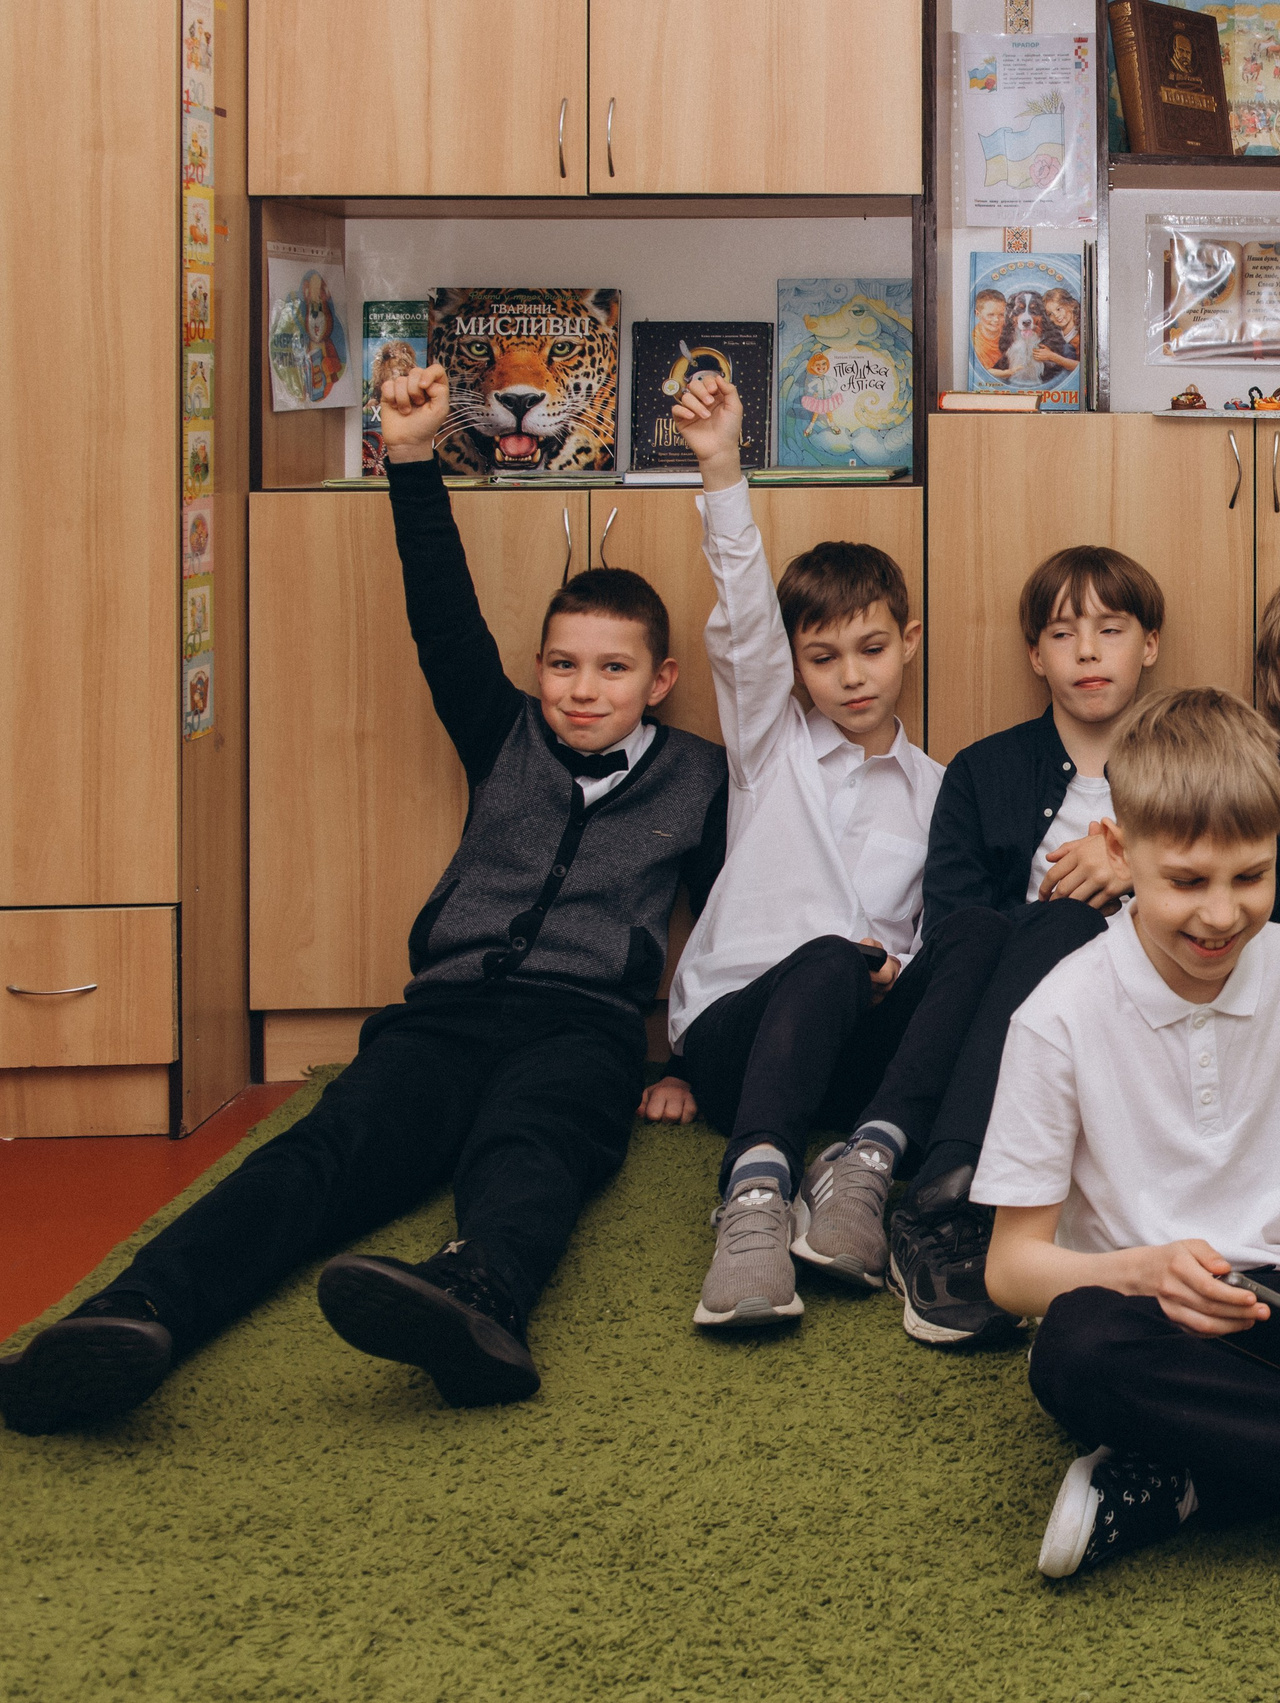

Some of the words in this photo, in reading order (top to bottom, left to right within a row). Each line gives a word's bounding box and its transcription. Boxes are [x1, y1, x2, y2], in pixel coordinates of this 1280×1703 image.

[183, 162, 204, 190] 120
[491, 304, 556, 315] ТВАРИНИ-
[184, 319, 206, 347] 100
[455, 316, 590, 338] МИСЛИВЦІ
